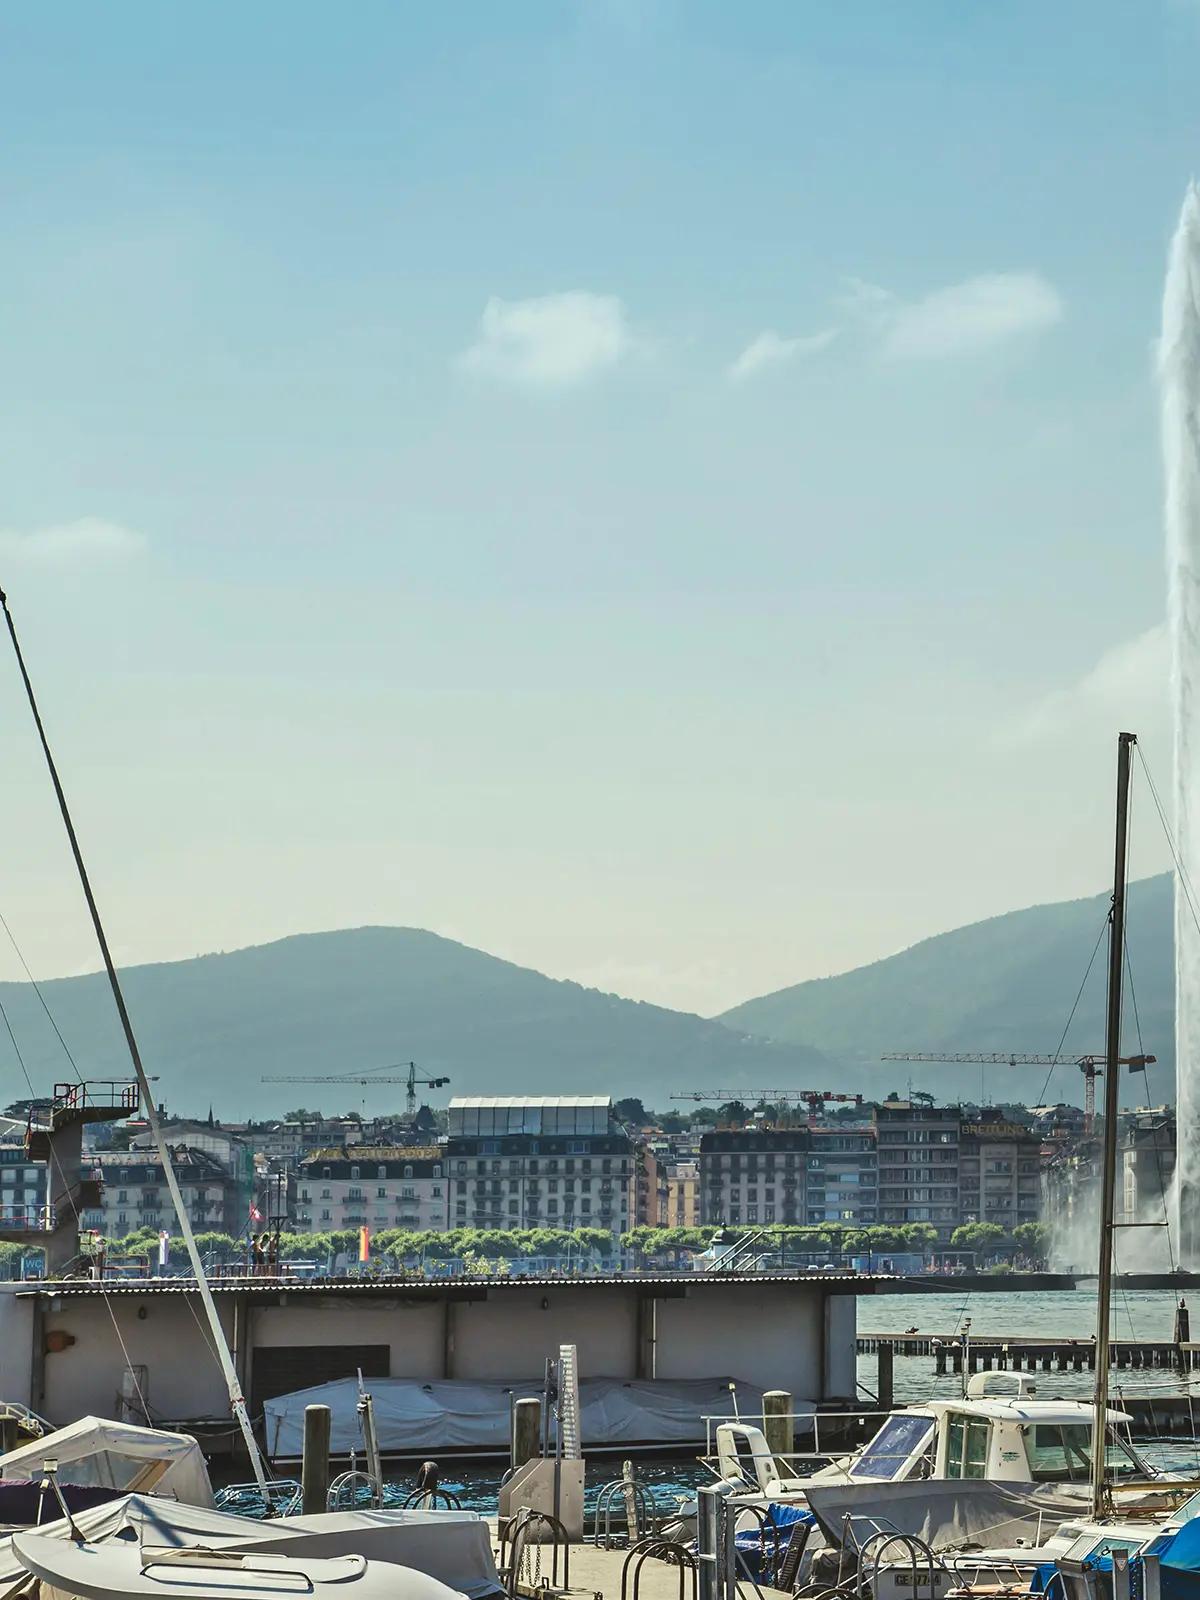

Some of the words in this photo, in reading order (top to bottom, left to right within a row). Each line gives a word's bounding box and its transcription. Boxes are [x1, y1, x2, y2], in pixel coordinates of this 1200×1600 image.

[962, 1125, 1024, 1134] BREITLING
[26, 1259, 42, 1269] WC
[896, 1575, 908, 1585] GE
